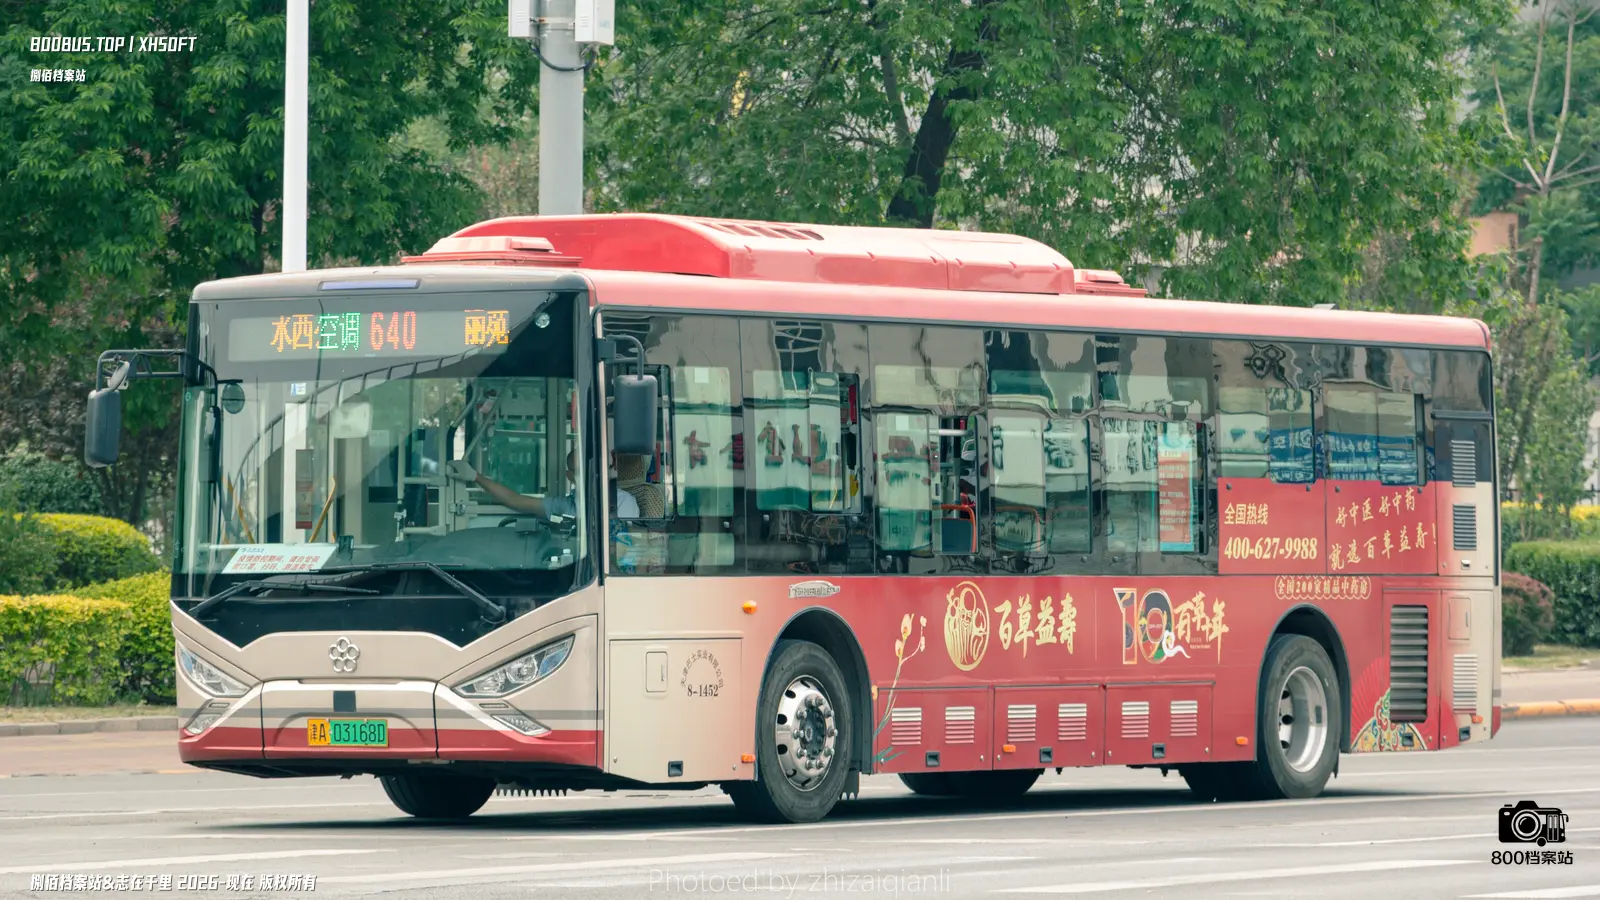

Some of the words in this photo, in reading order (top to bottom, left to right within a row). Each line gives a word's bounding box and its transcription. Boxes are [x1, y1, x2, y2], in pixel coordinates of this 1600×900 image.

[370, 311, 417, 350] 640
[1224, 502, 1268, 526] 全国热线
[1335, 496, 1375, 529] 好中医
[1224, 537, 1318, 560] 400-627-9988
[687, 684, 719, 697] 8-1452
